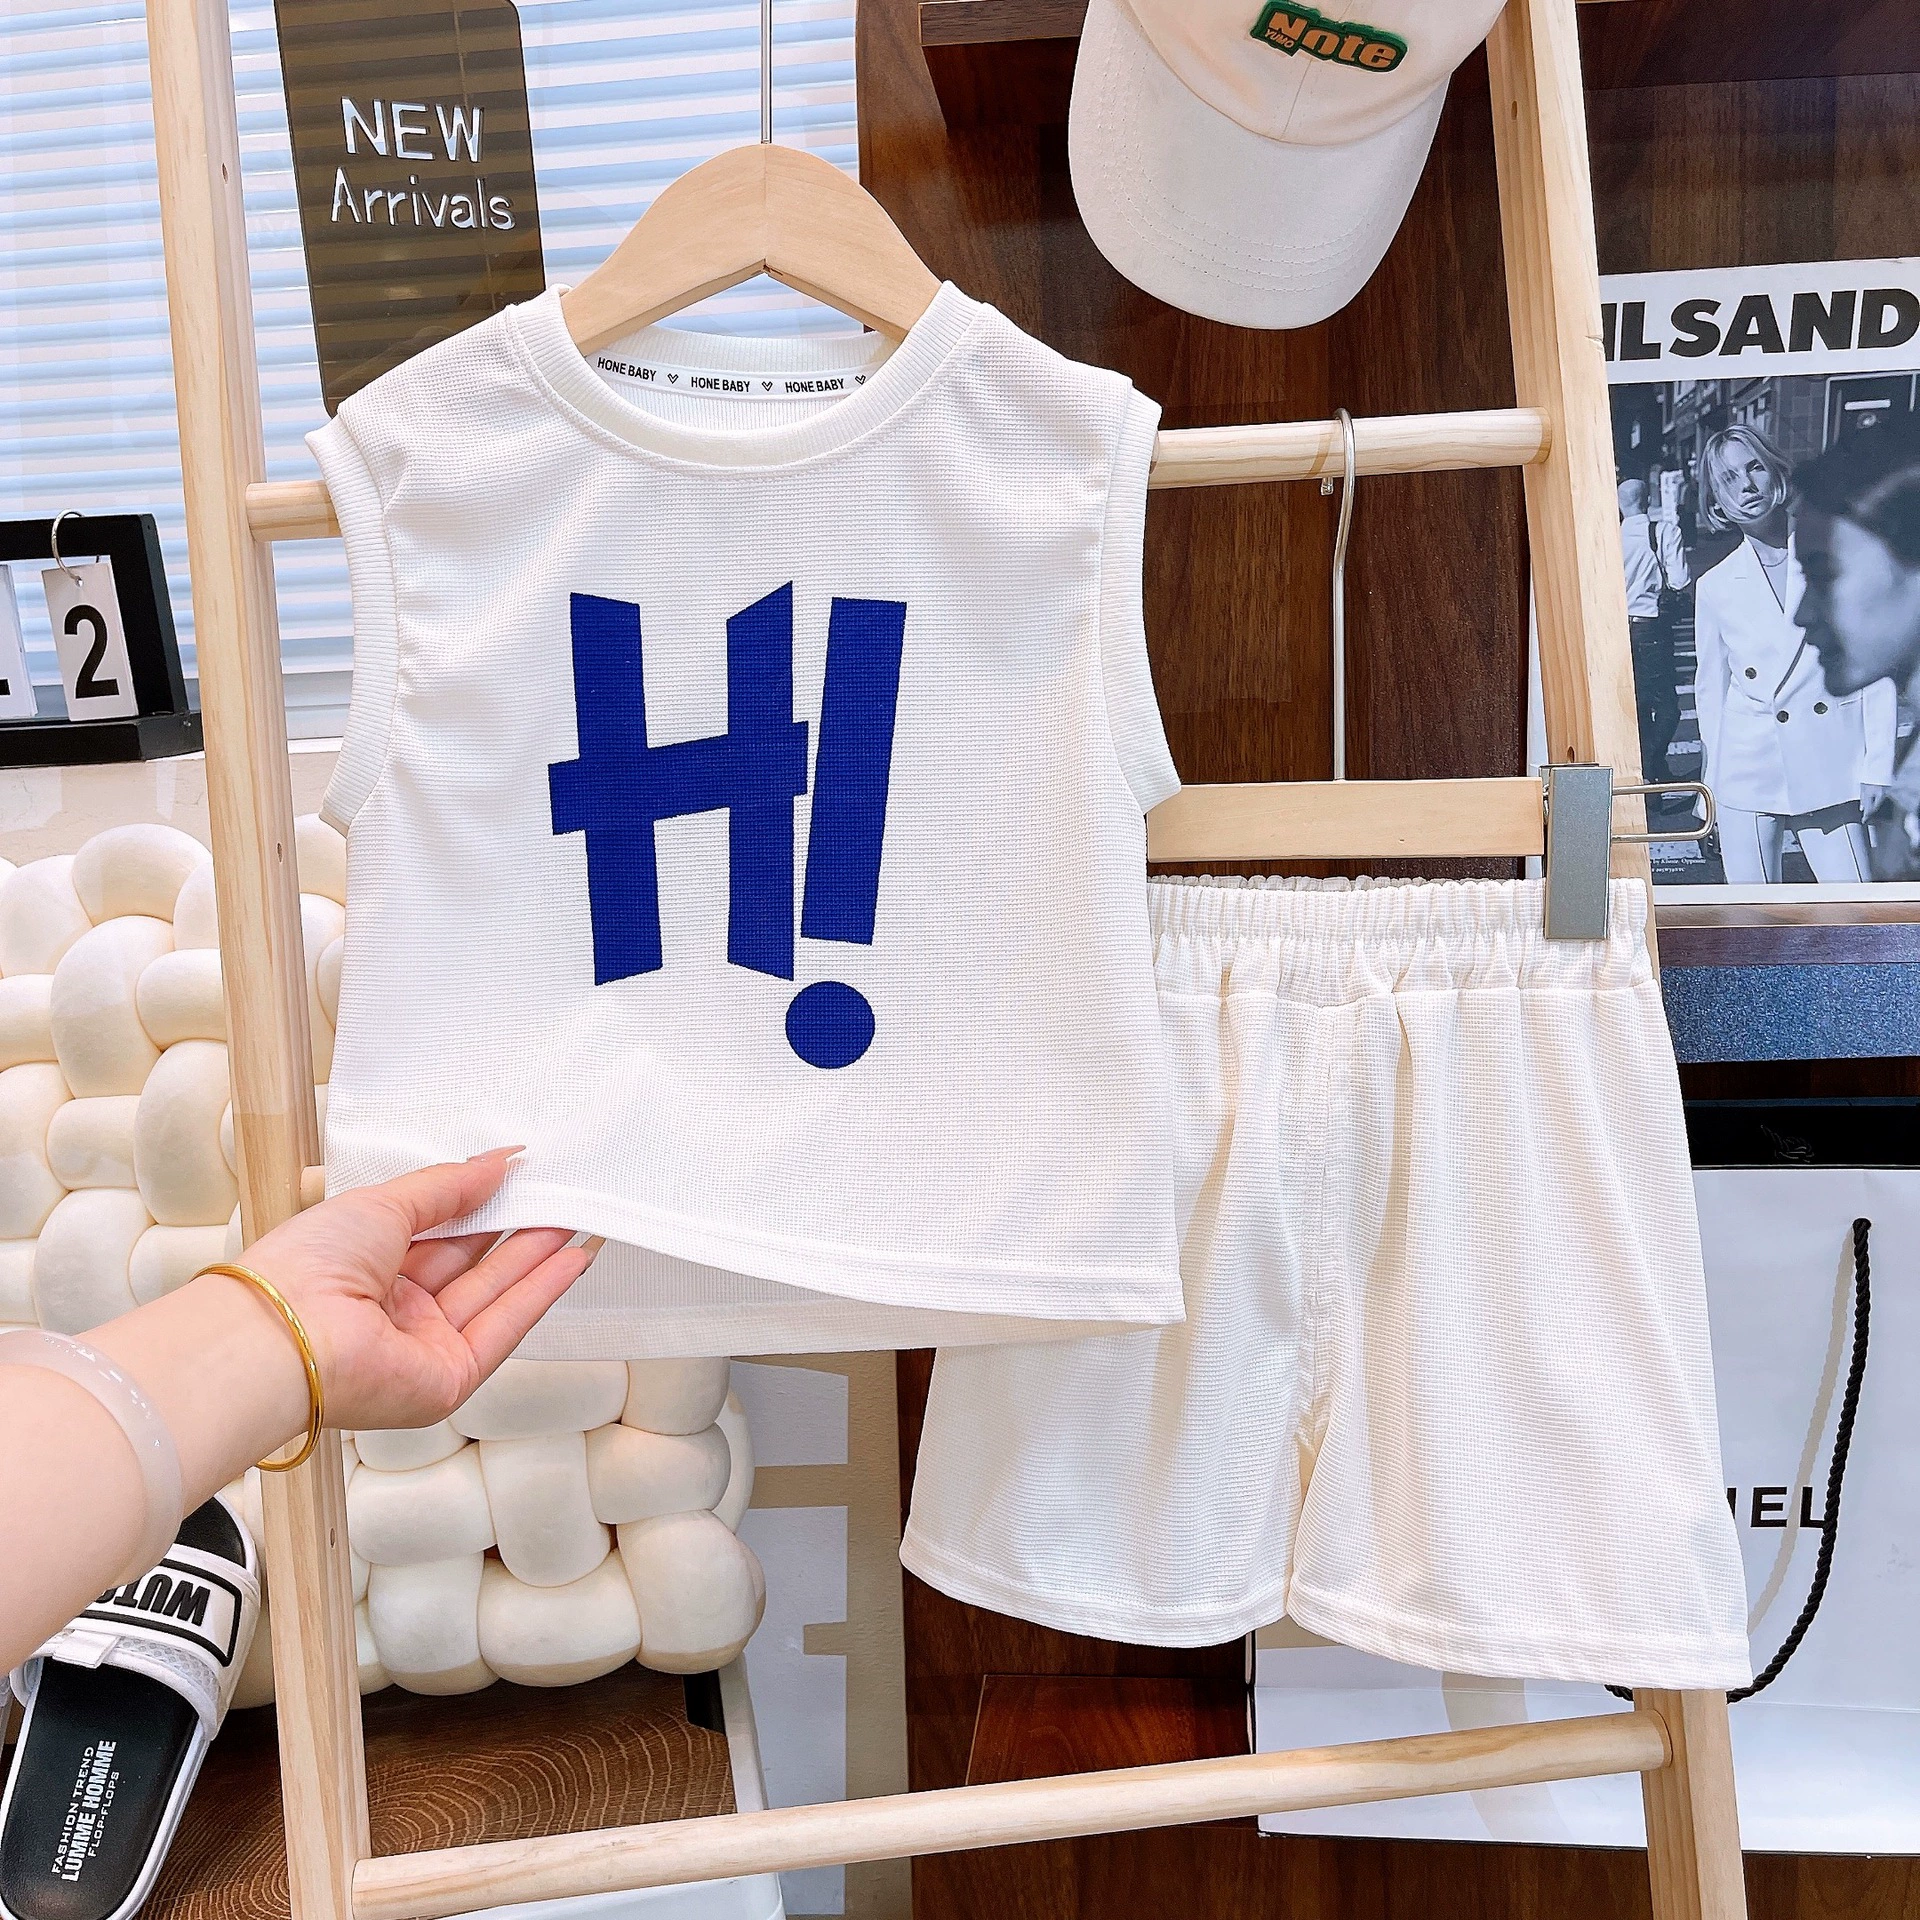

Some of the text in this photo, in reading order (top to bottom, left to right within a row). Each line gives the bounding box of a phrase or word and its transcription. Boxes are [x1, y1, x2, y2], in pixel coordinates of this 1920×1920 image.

[1268, 11, 1397, 69] Note
[341, 96, 485, 162] NEW
[330, 166, 516, 230] Arrivals
[597, 356, 657, 382] HONE BABY
[691, 376, 751, 393] HONE BABY
[785, 378, 845, 393] HONE BABY
[64, 604, 120, 699] 2
[1727, 1486, 1829, 1529] EL
[51, 1746, 95, 1874] FASHION TREND
[61, 1740, 117, 1882] LUMME HOMME
[87, 1771, 120, 1857] FLOP-FLOPS
